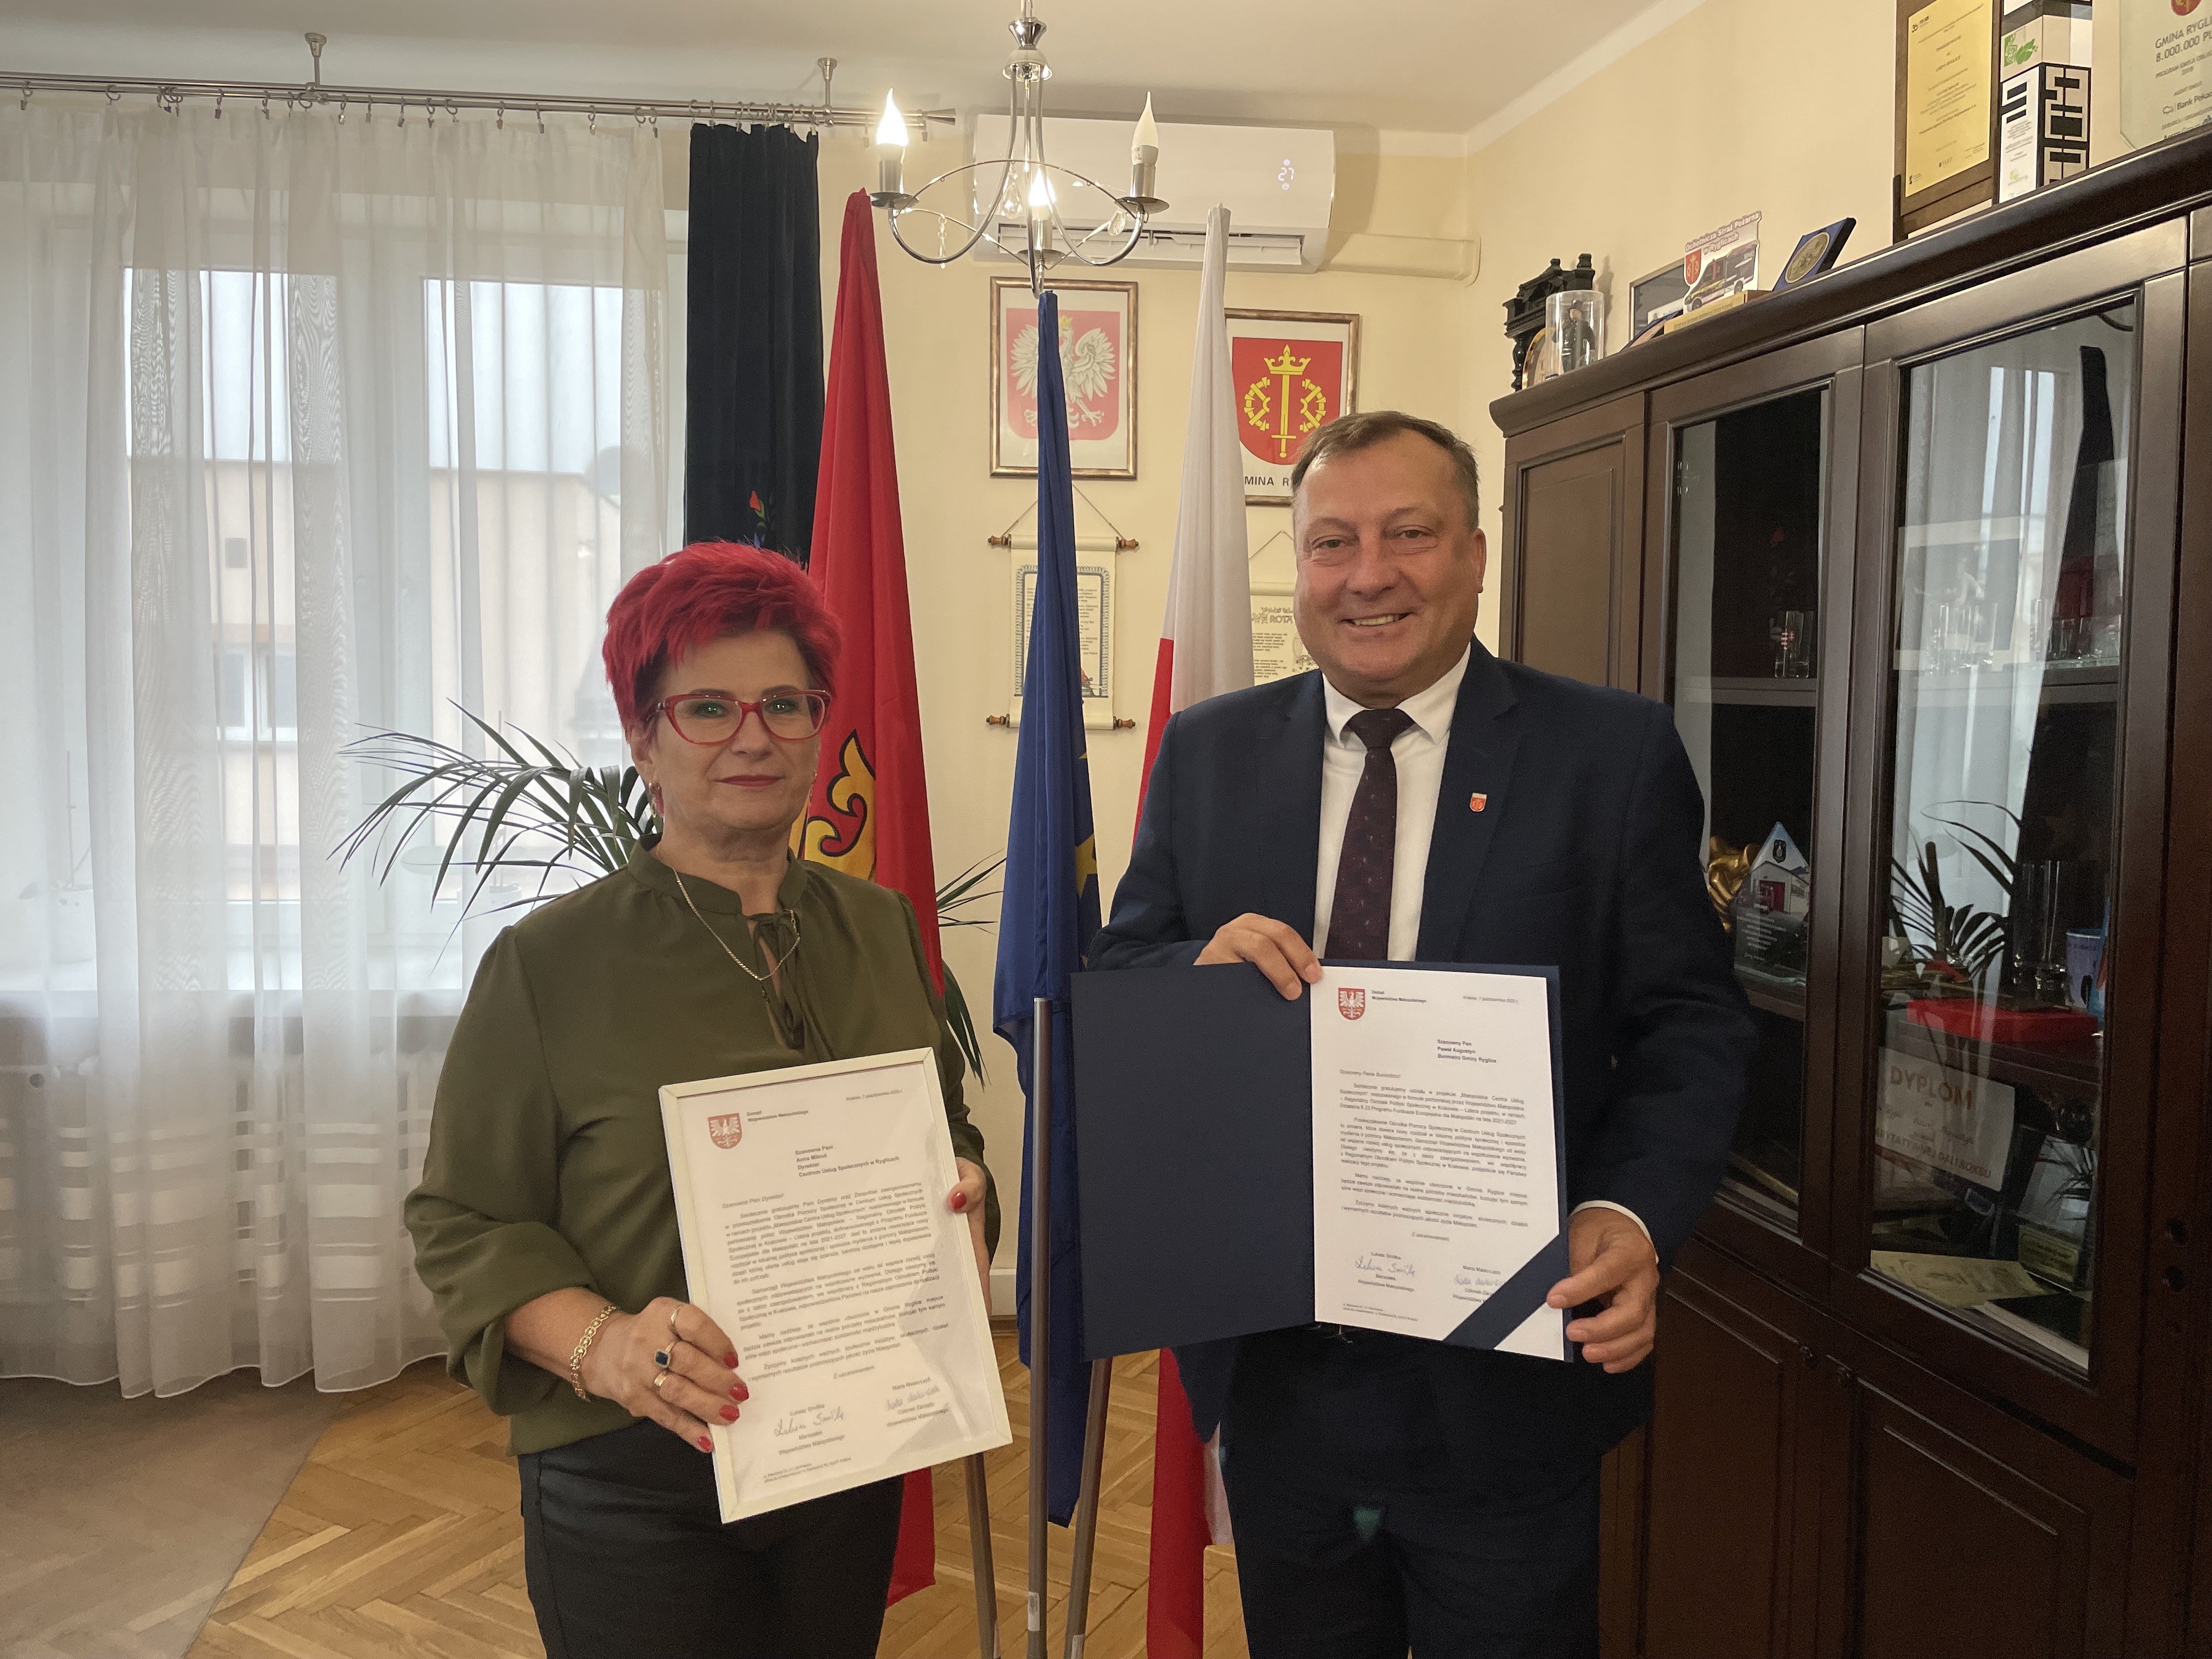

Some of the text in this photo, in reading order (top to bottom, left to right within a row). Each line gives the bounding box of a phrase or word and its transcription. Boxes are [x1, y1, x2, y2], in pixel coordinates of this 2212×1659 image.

[2155, 30, 2184, 48] GMINA
[2155, 35, 2200, 62] 8.000.000
[2177, 98, 2193, 110] Bank
[1278, 167, 1294, 181] 27
[1685, 233, 1717, 252] Ochotnicza
[1735, 212, 1759, 229] Pożarna
[1709, 232, 1739, 252] Ryglicach
[1244, 476, 1274, 486] MINA
[1269, 615, 1293, 624] ROTA
[1891, 1065, 1972, 1110] DYPLOM
